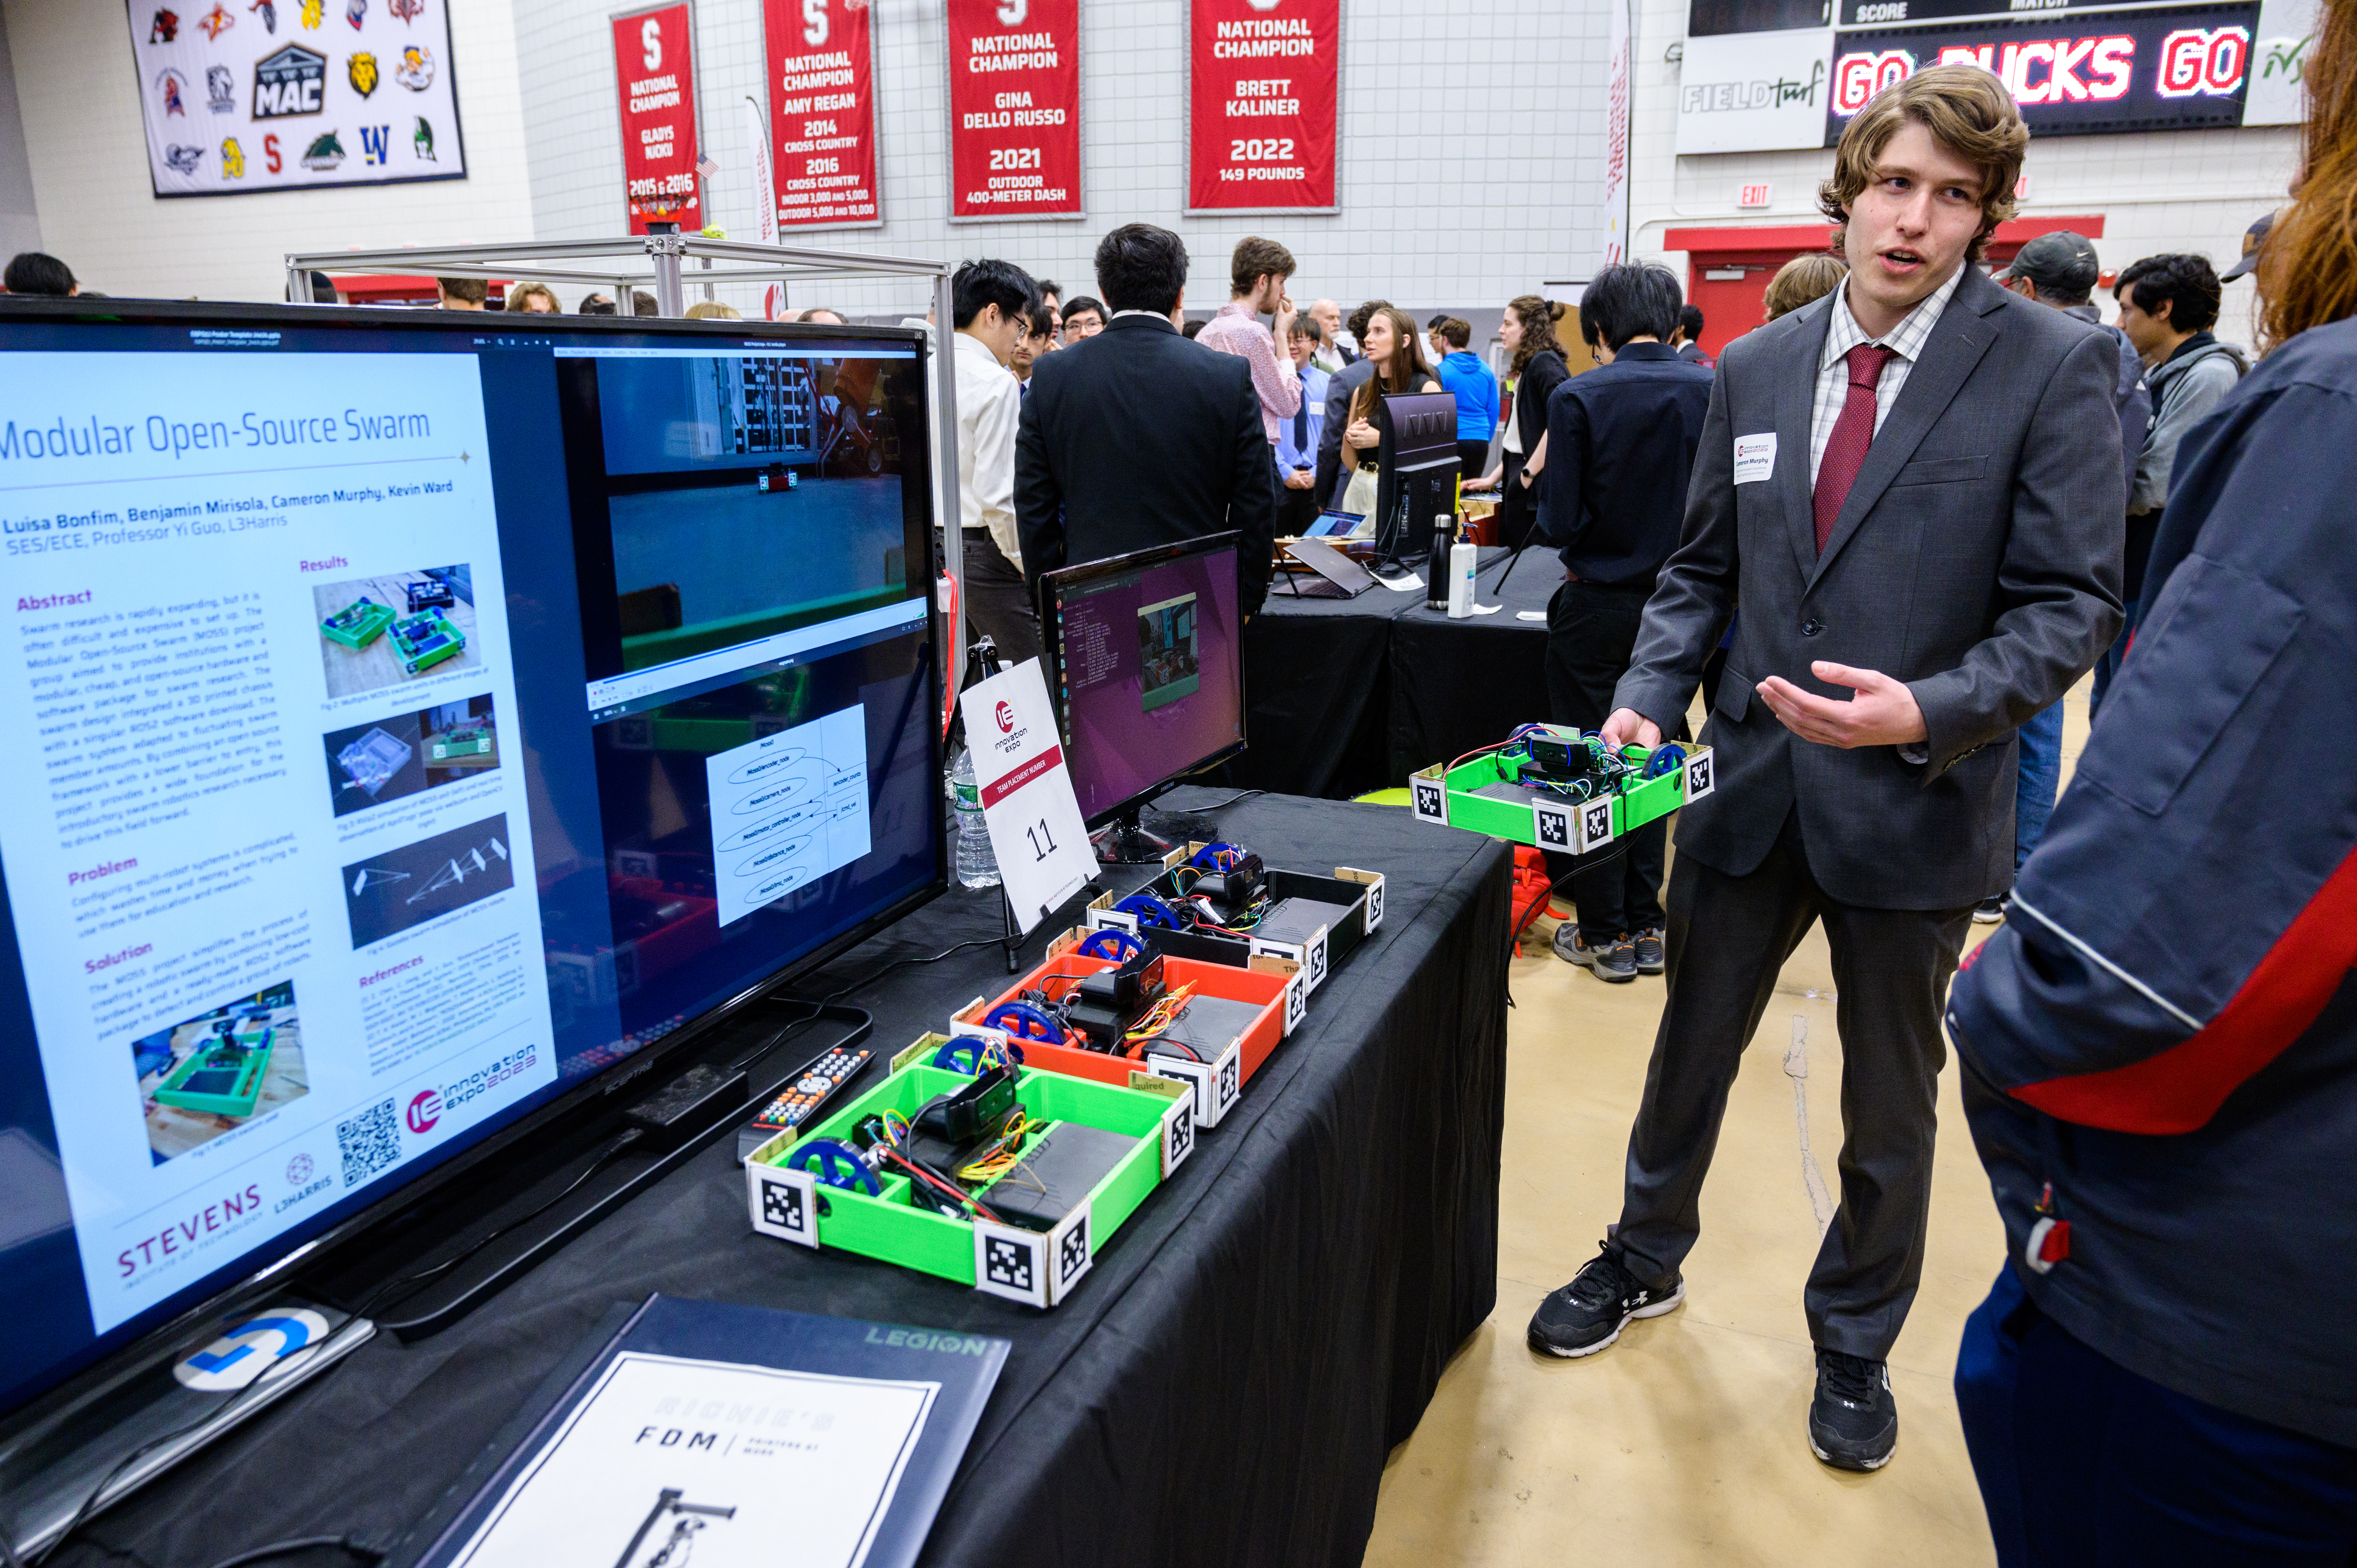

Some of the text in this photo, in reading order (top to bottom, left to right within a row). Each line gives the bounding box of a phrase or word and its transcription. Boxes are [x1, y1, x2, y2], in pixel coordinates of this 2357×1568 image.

[1856, 2, 1907, 22] SCORE
[1217, 18, 1312, 39] NATIONAL
[642, 18, 661, 72] S
[972, 32, 1055, 54] NATIONAL
[1214, 38, 1314, 59] CHAMPION
[784, 50, 852, 74] NATIONAL
[969, 51, 1058, 73] CHAMPION
[2157, 26, 2250, 98] GO
[631, 74, 678, 97] NATIONAL
[783, 68, 853, 92] CHAMPION
[1236, 79, 1291, 97] BRETT
[255, 79, 322, 117] MAC
[630, 90, 680, 113] CHAMPION
[784, 92, 855, 115] AMY REGAN
[995, 91, 1033, 109] GINA
[1226, 99, 1300, 117] KALINER
[804, 119, 837, 138] 2014
[964, 108, 1065, 129] DELLO RUSSO
[360, 125, 390, 166] W
[641, 125, 674, 144] GLADYS
[784, 136, 858, 154] CROSS COUNTRY
[263, 132, 282, 174] S
[645, 142, 673, 160] NJOKU
[990, 148, 1041, 170] 2021
[1231, 138, 1294, 161] 2022
[806, 157, 839, 175] 2016
[1219, 167, 1305, 181] 149 POUNDS
[629, 178, 657, 195] 2015
[666, 173, 694, 193] 2016
[787, 175, 860, 191] CROSS COUNTRY
[988, 175, 1043, 189] OUTDOOR
[781, 189, 868, 205] INDOOR 3,000 AND 5,000
[966, 189, 1066, 204] 400-METER DASH
[1741, 184, 1769, 206] EXIT
[778, 203, 875, 220] OUTDOOR 5,000 AND 10,000
[146, 412, 337, 459] Open-Source
[344, 409, 430, 441] Swarm
[3, 480, 453, 534] Luisa Bonfim, Benjamin Mirisola, Cameron Murphy, Kevin Ward
[7, 514, 288, 555] SES/ECE, Professor Yi Guo, L3Harris
[300, 556, 348, 572] Results
[17, 590, 92, 612] Abstract
[995, 728, 1028, 750] innovation
[1005, 741, 1021, 753] expo
[997, 760, 1046, 793] TEAM PLACEMENT NUMBER
[1161, 781, 1174, 792] SAMSUNG
[1027, 818, 1057, 862] 11
[69, 857, 138, 886] Problem
[1053, 888, 1063, 899] INSTITUTE
[1065, 877, 1078, 888] TECHNOLOGY
[85, 943, 153, 975] Solution
[359, 955, 425, 989] References
[274, 1175, 333, 1215] L3HARRIS
[119, 1183, 261, 1278] STEVENS
[865, 1326, 988, 1357] LEGION
[655, 1395, 836, 1431] RICHIE'S
[635, 1425, 719, 1451] FDM
